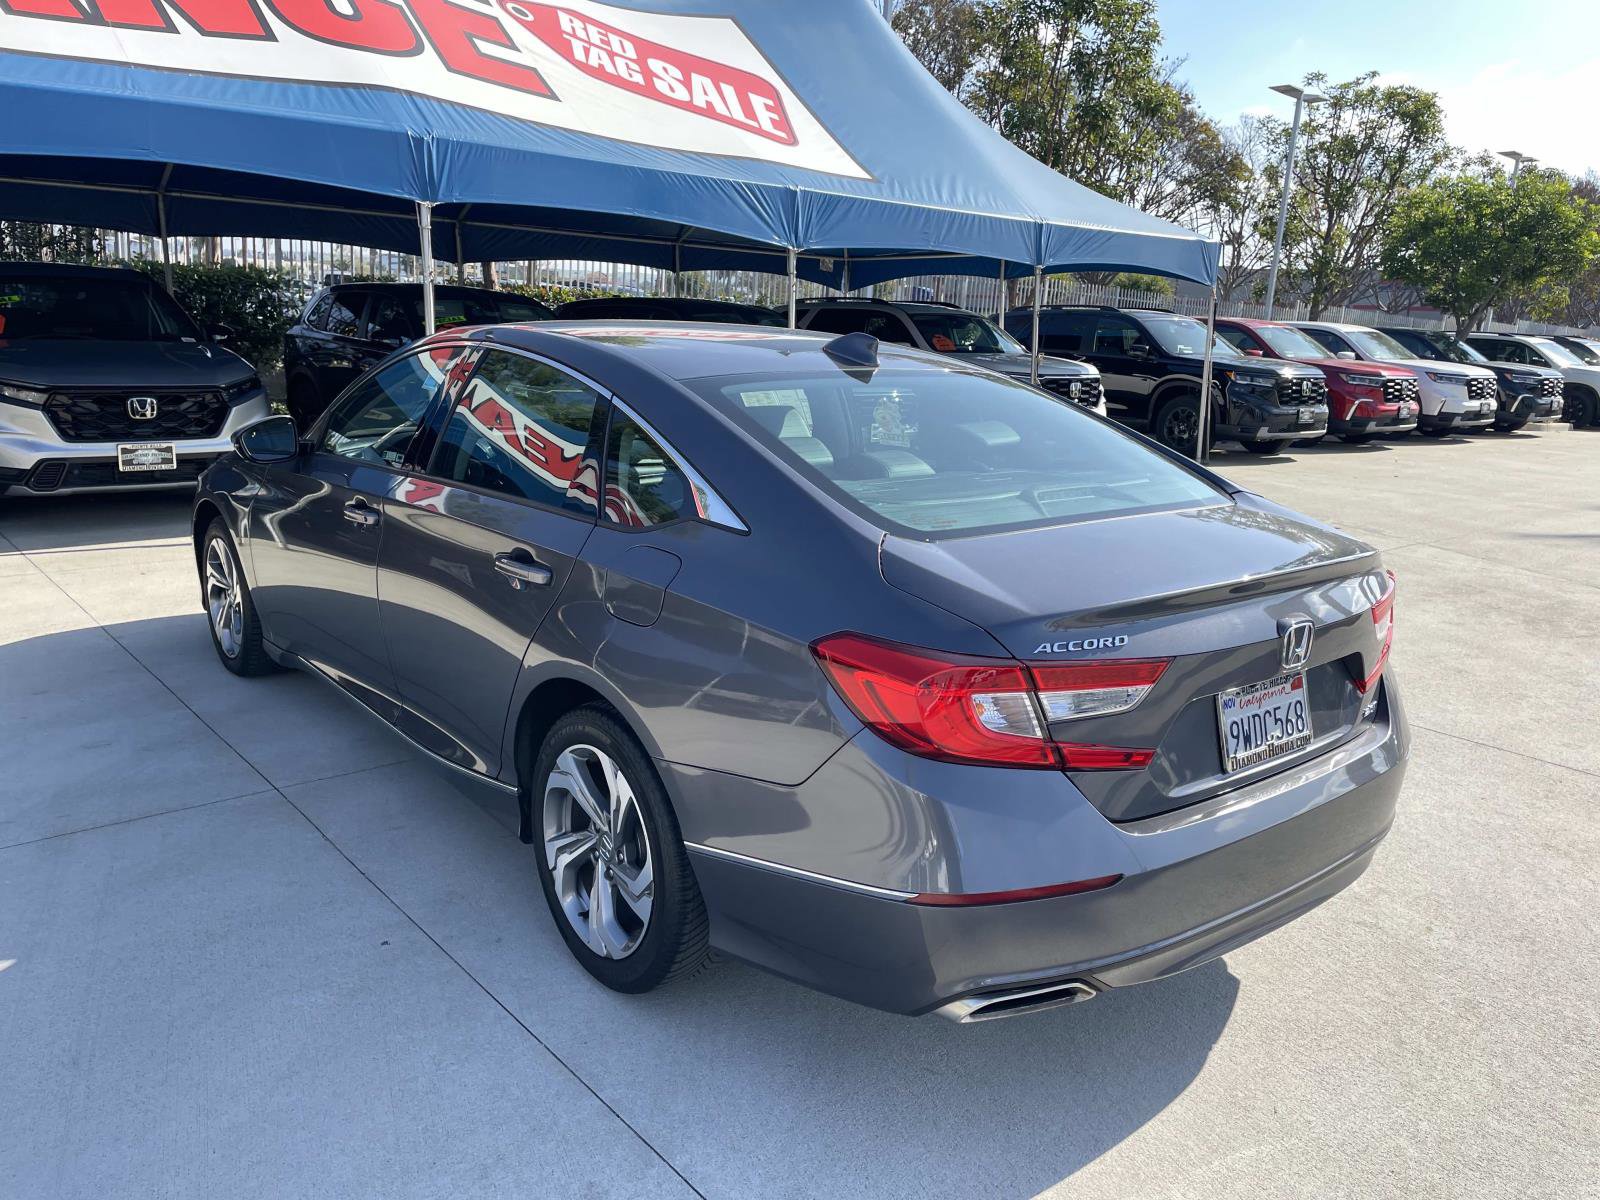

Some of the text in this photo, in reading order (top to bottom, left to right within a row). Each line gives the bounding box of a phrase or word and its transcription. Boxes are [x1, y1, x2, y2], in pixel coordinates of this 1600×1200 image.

[557, 10, 637, 59] RED
[562, 34, 645, 86] TAG
[647, 58, 788, 139] SALE
[1033, 634, 1129, 654] ACCORD
[1229, 700, 1305, 756] 9WDC568
